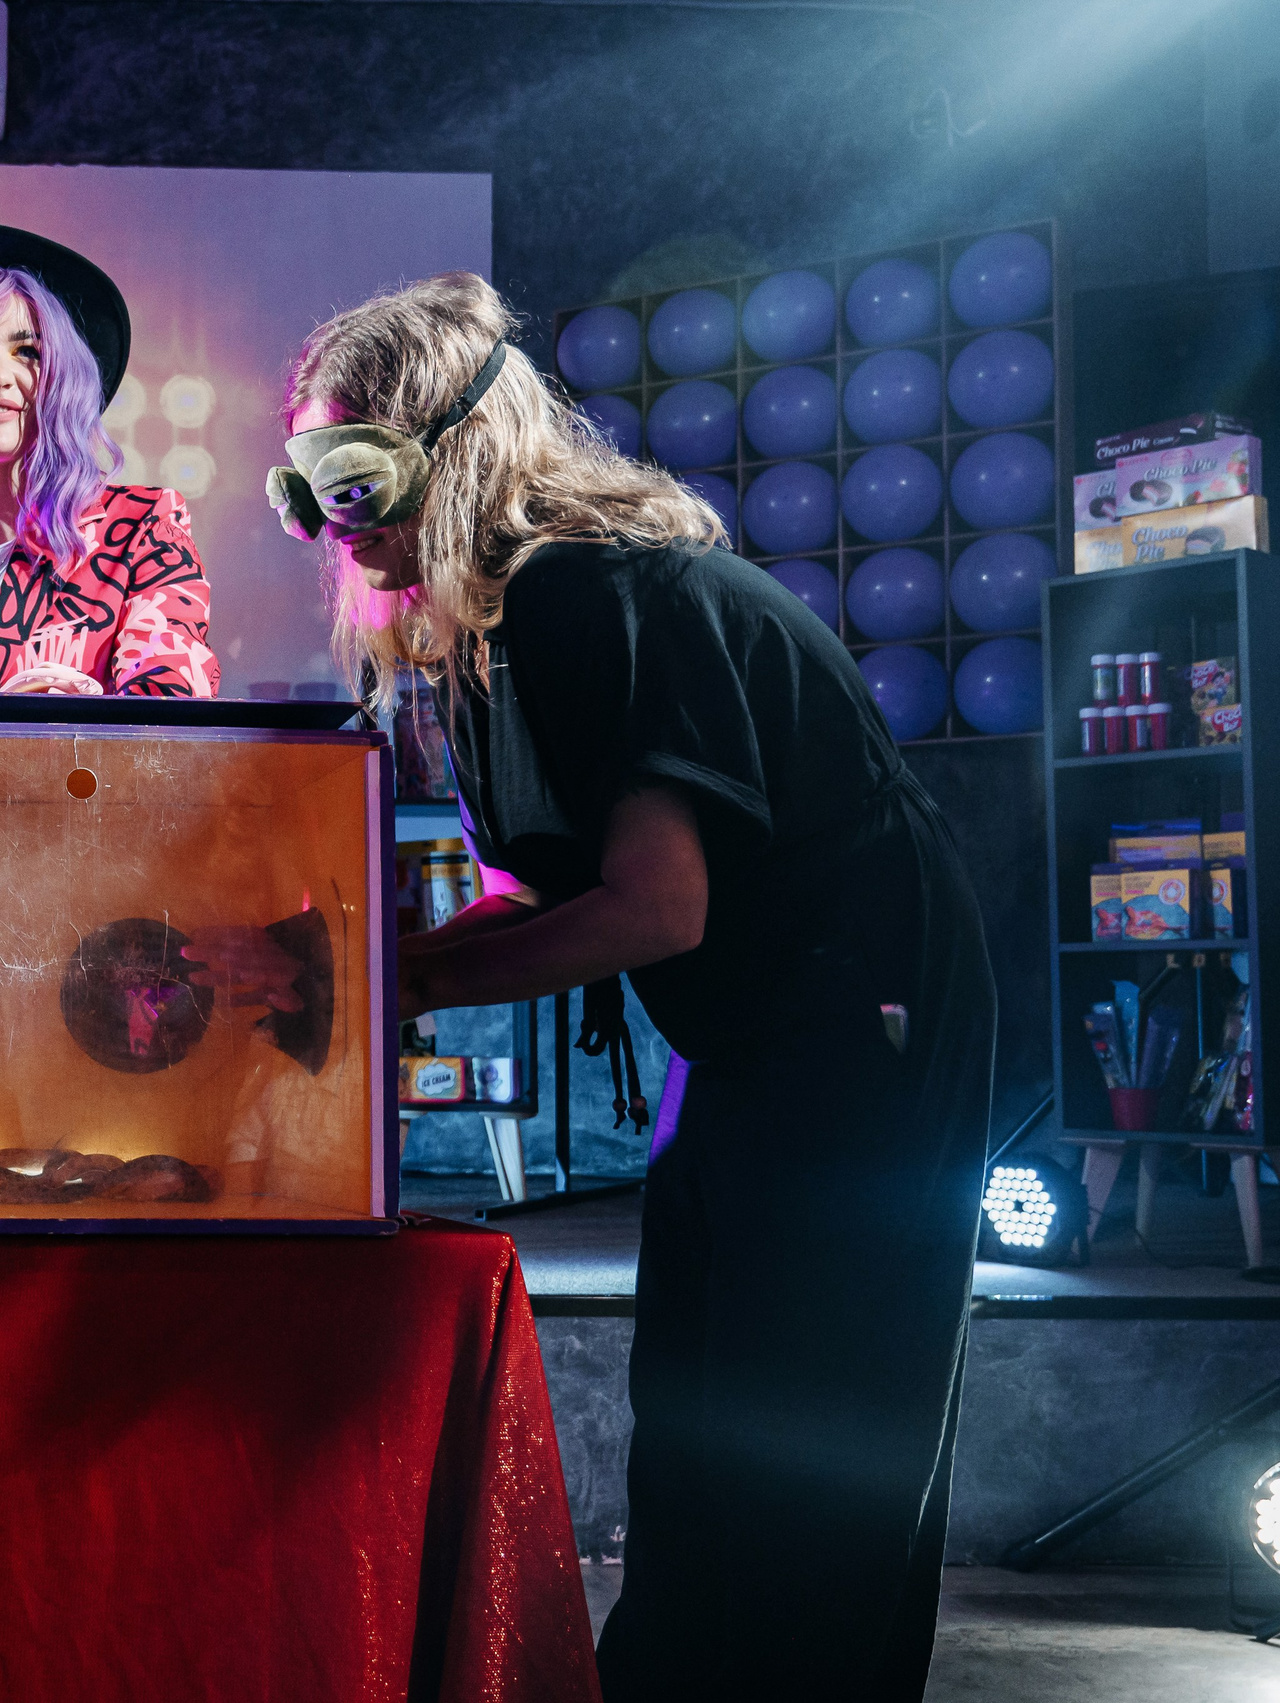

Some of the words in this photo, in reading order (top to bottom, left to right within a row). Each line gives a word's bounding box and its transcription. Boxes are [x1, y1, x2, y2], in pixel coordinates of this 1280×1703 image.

[1096, 443, 1131, 460] Choco
[1131, 436, 1151, 452] Pie
[1143, 464, 1189, 482] Choco
[1191, 457, 1218, 475] Pie
[1131, 525, 1188, 545] Choco
[1135, 544, 1165, 562] Pie
[422, 1079, 430, 1088] ICE
[432, 1073, 451, 1085] CREAM
